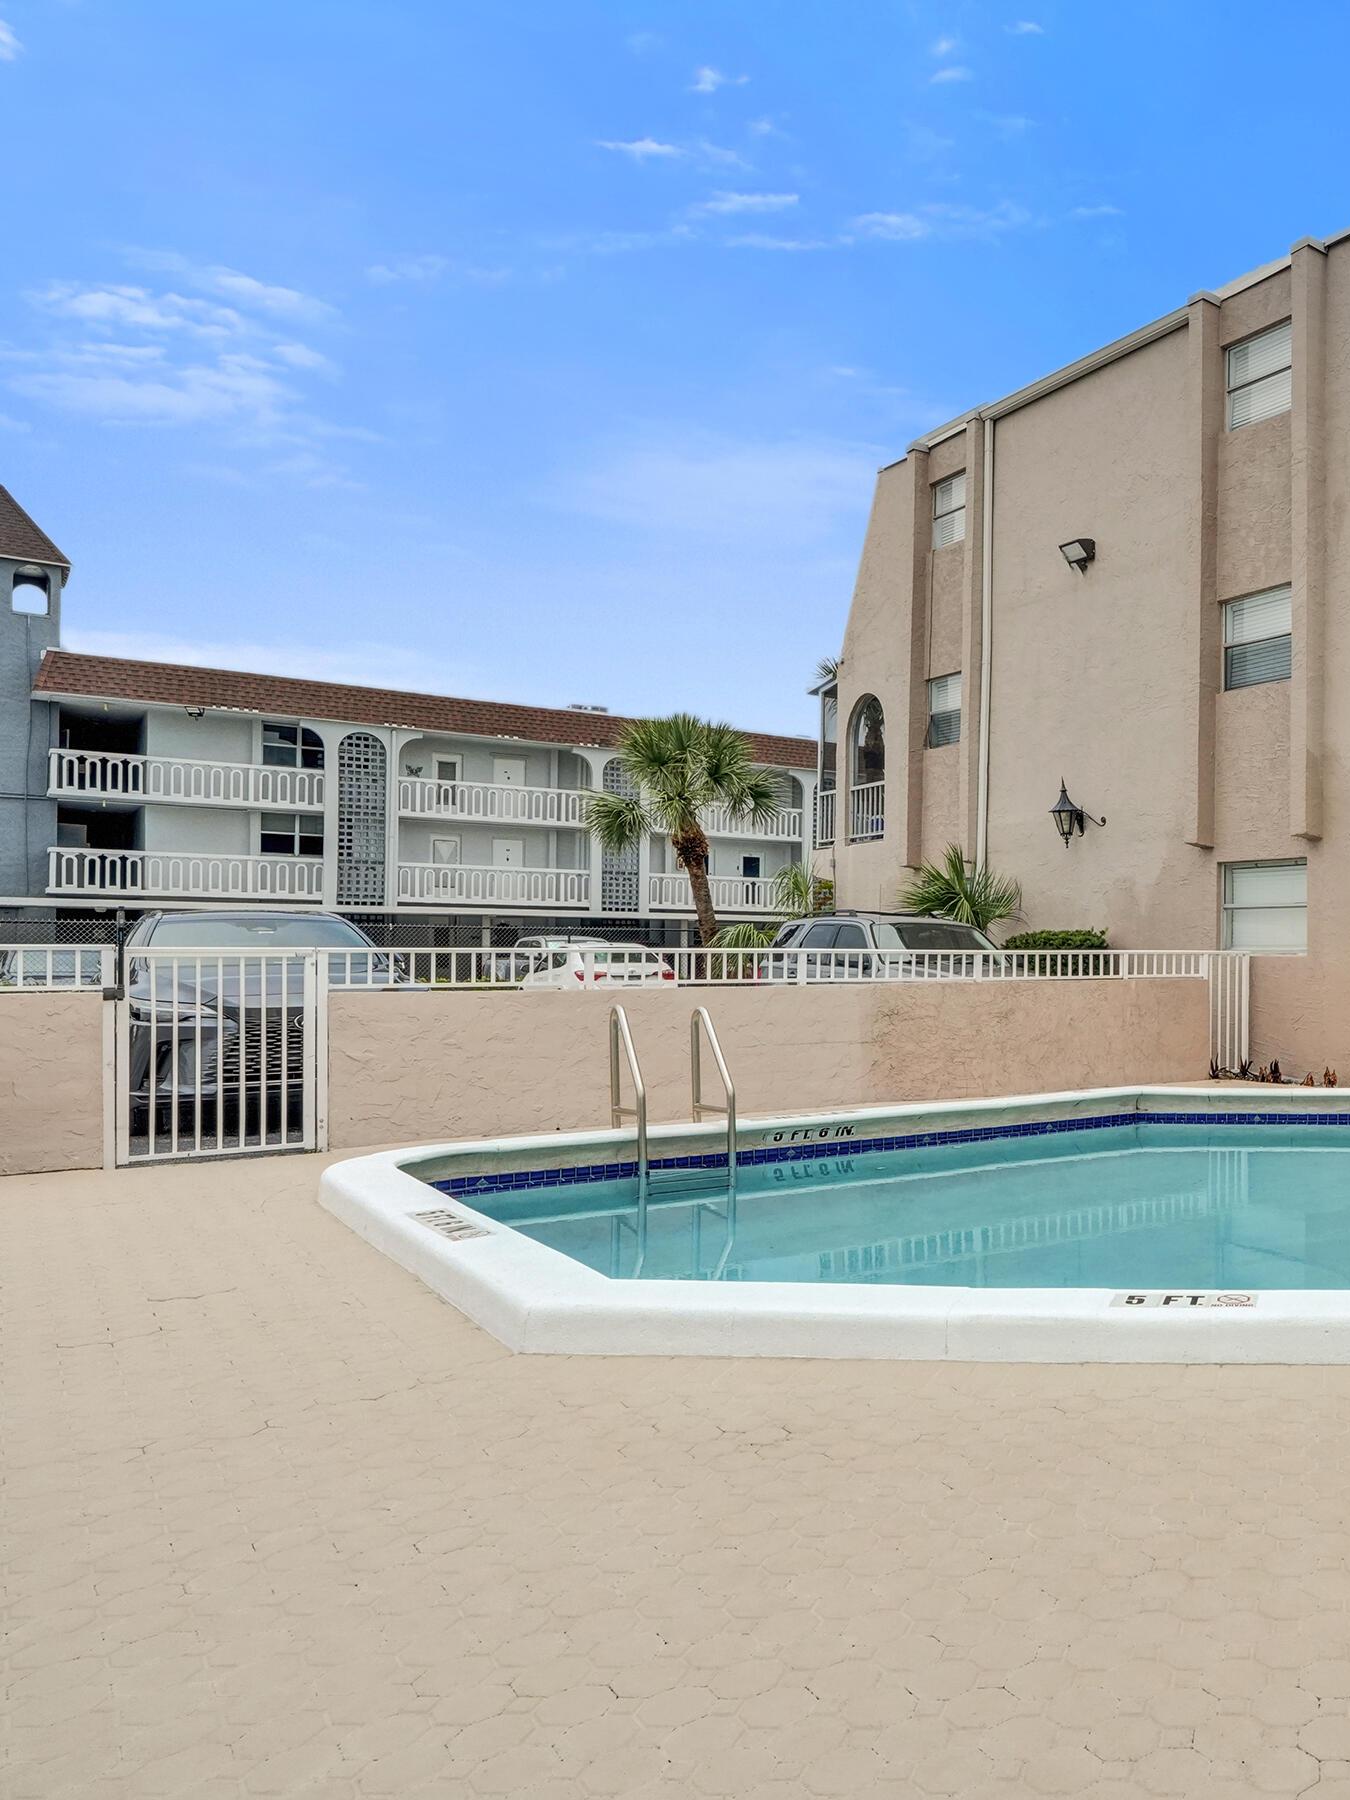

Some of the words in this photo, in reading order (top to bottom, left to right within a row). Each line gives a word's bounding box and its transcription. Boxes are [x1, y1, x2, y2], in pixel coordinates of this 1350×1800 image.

[818, 1127, 830, 1138] 6
[1125, 1295, 1147, 1305] 5
[1162, 1295, 1206, 1306] FT.
